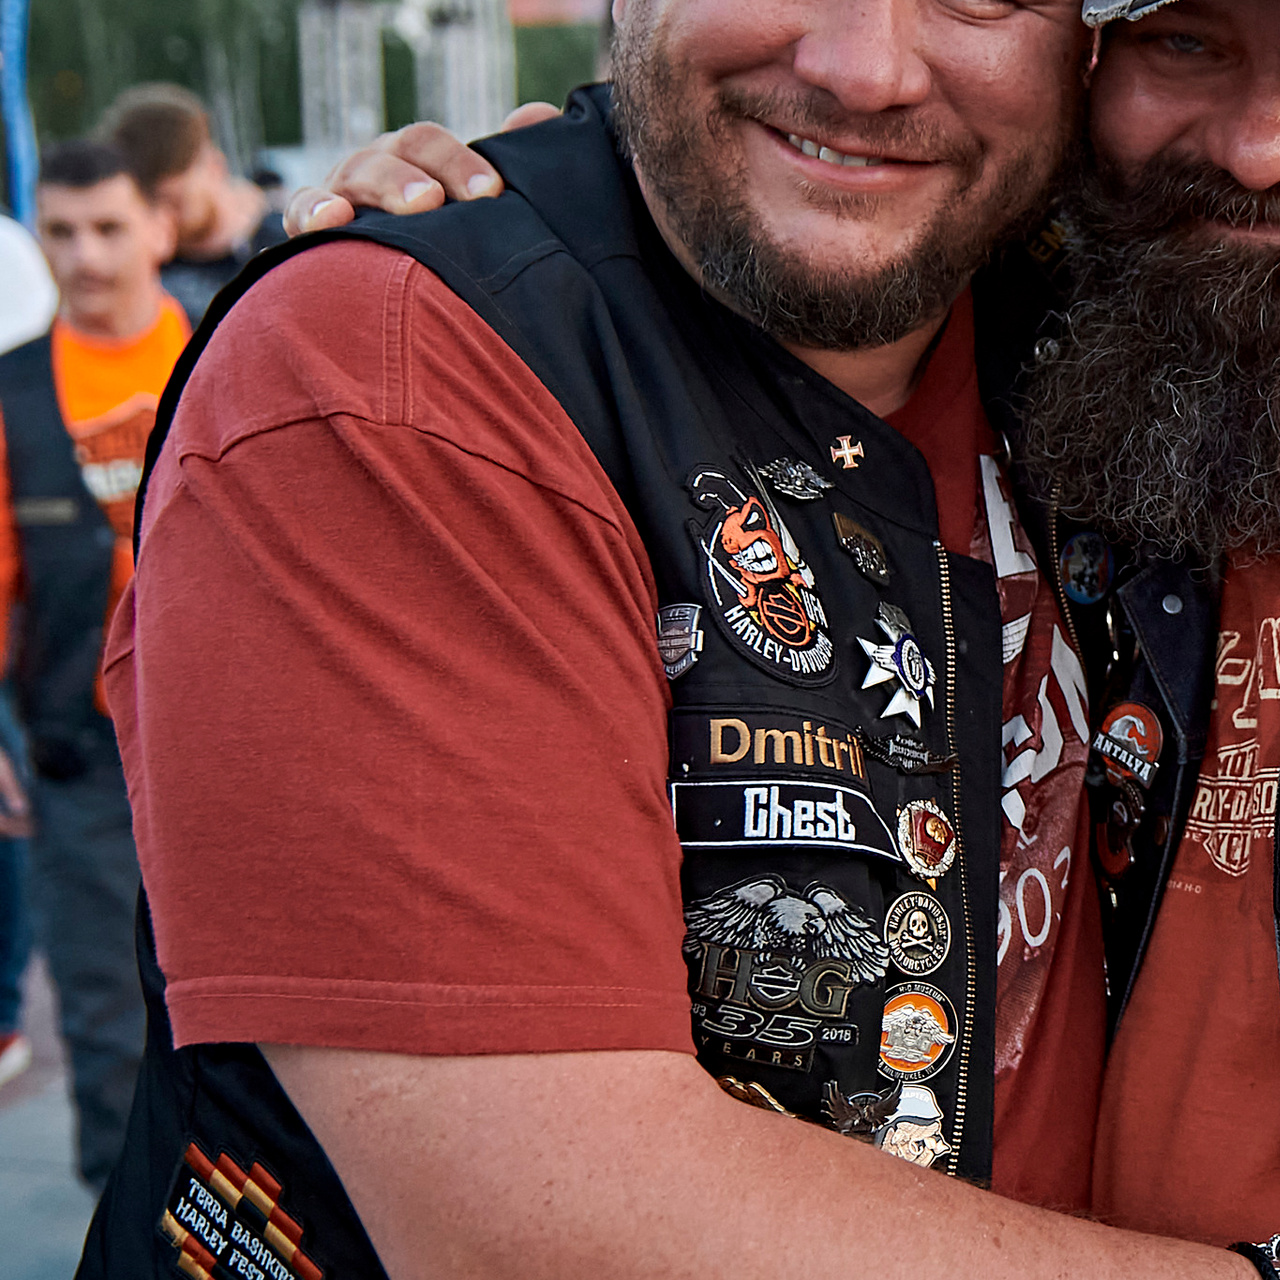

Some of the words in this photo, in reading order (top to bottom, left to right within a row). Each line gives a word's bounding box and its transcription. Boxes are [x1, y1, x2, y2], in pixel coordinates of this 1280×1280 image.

[1092, 732, 1152, 781] ANTALYA
[744, 786, 856, 841] Chest
[701, 1004, 822, 1046] 35
[821, 1027, 852, 1042] 2018
[701, 1035, 803, 1067] YEARS
[175, 1196, 228, 1256] HARLEY
[189, 1177, 228, 1229] TERRA
